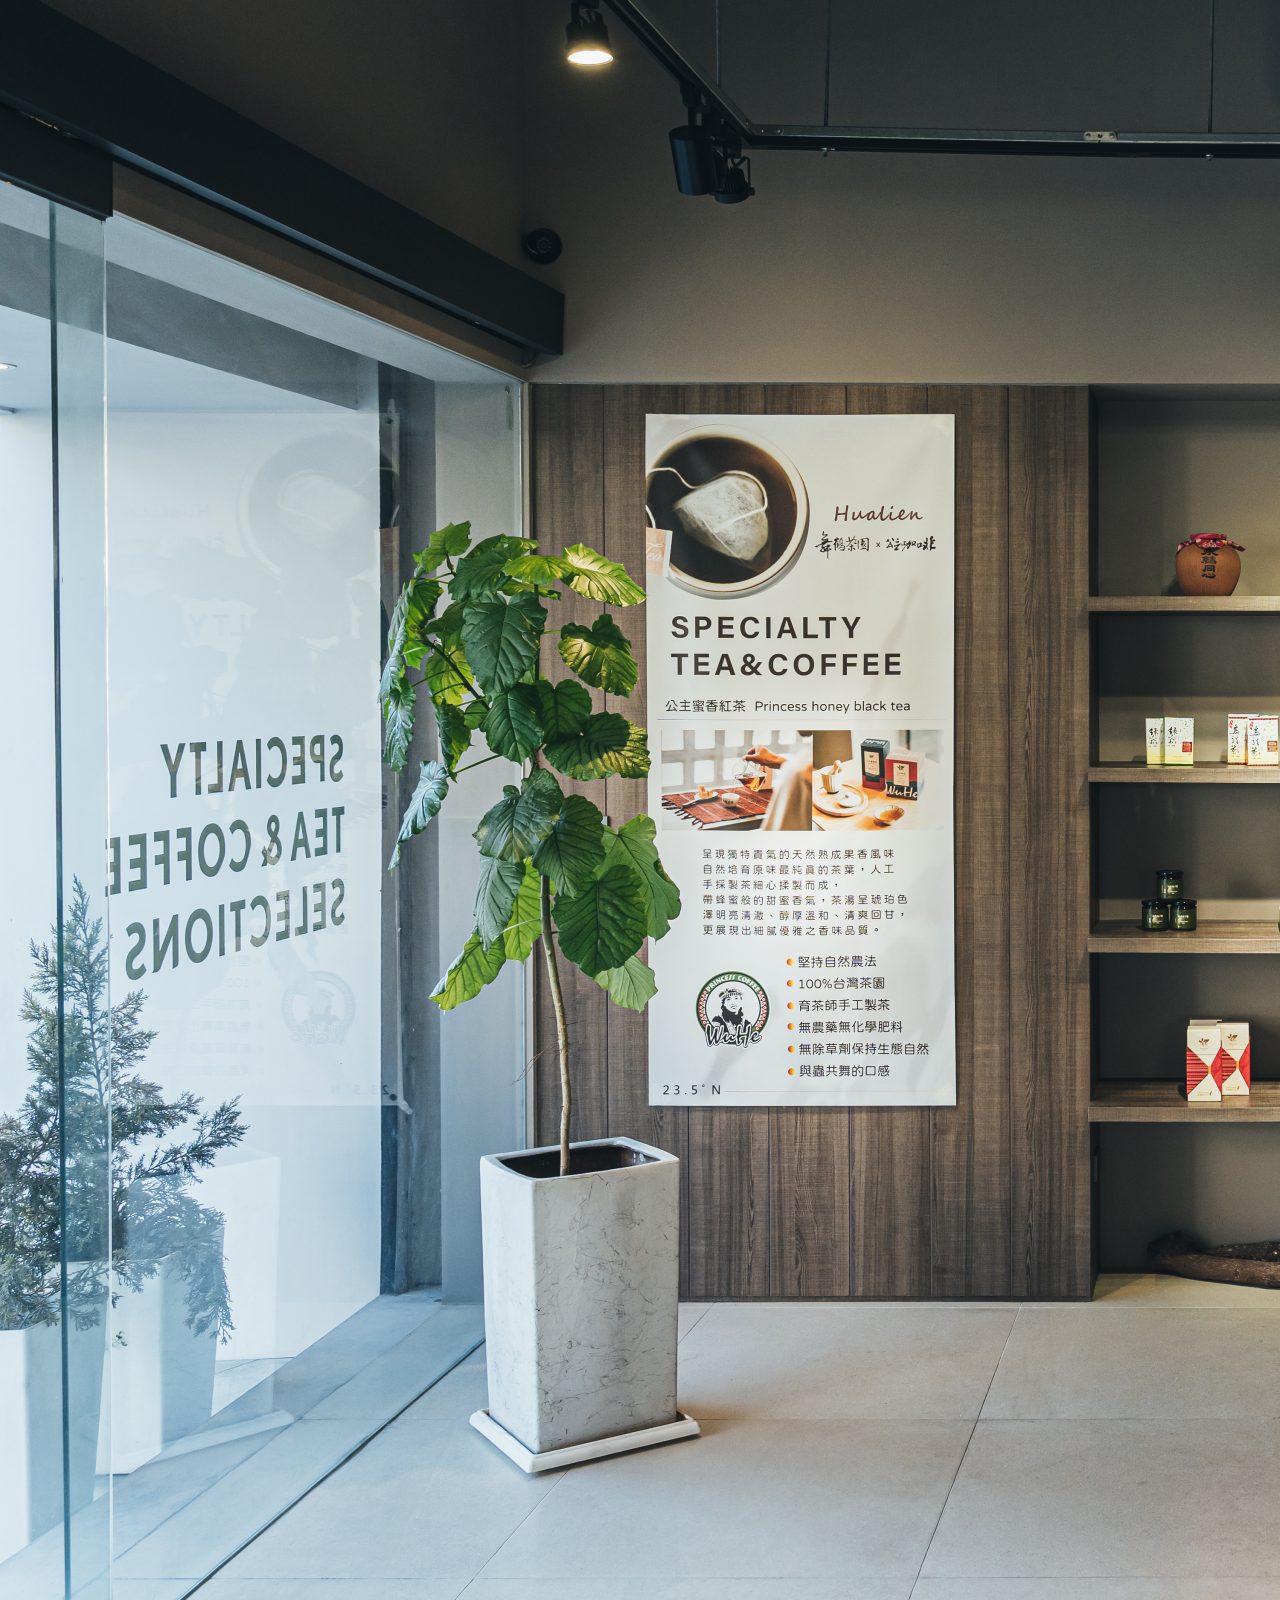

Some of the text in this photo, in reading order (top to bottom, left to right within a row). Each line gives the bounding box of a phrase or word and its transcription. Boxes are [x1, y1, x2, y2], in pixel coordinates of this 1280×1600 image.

[834, 504, 924, 522] Hualien
[671, 615, 862, 639] SPECIALTY
[670, 653, 902, 677] TEA&COFFEE
[665, 699, 911, 715] 公主蜜香紅茶 Princess honey black tea
[798, 954, 877, 968] 堅持自然農法
[705, 974, 761, 993] PRINCESS COFFEE
[799, 976, 885, 990] 100%台灣茶園
[798, 998, 891, 1012] 育茶師手工製茶
[798, 1020, 903, 1034] 無農藥無化學肥料
[705, 1023, 763, 1048] WuHe
[798, 1042, 930, 1056] 無除草劑保持生態自然
[799, 1064, 891, 1078] 與蟲共舞的口感
